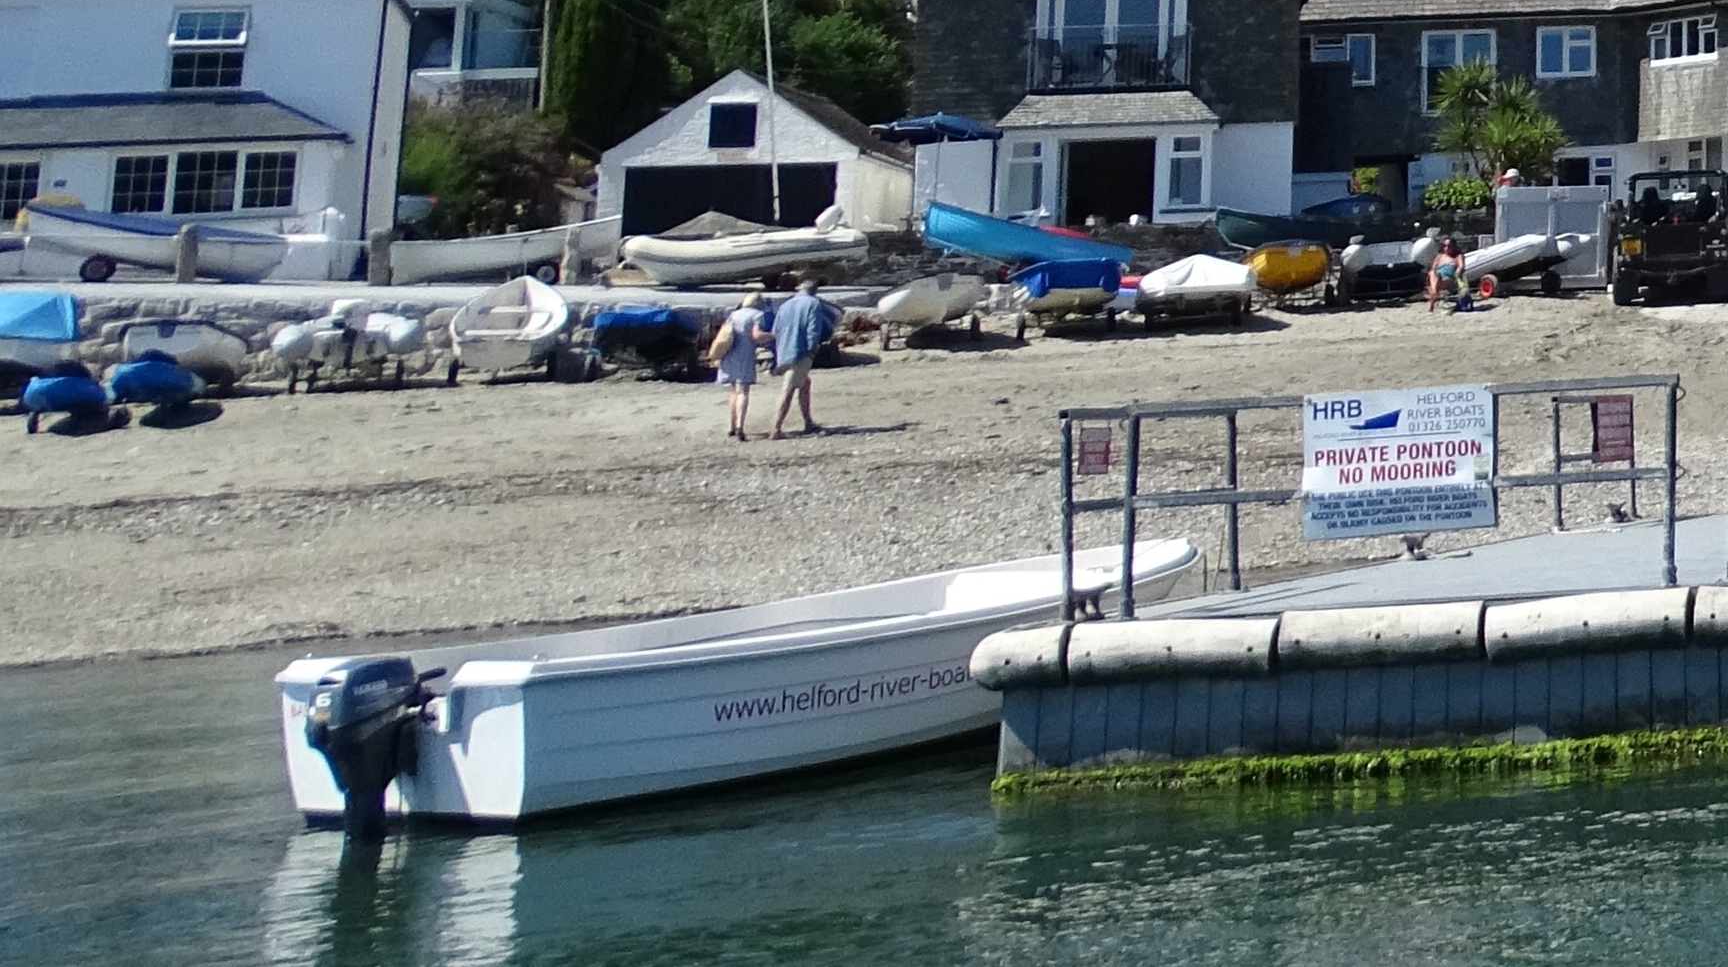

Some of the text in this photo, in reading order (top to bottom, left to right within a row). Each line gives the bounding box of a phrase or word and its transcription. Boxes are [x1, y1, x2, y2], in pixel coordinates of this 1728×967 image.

[1416, 391, 1475, 405] HELFORD
[1312, 399, 1363, 421] HRB
[1407, 404, 1485, 420] RIVER BOATS
[1407, 417, 1486, 433] 01326 250770
[1314, 439, 1482, 467] PRIVATE PONTOON
[1338, 460, 1457, 484] NO MOORING
[315, 692, 332, 707] 6
